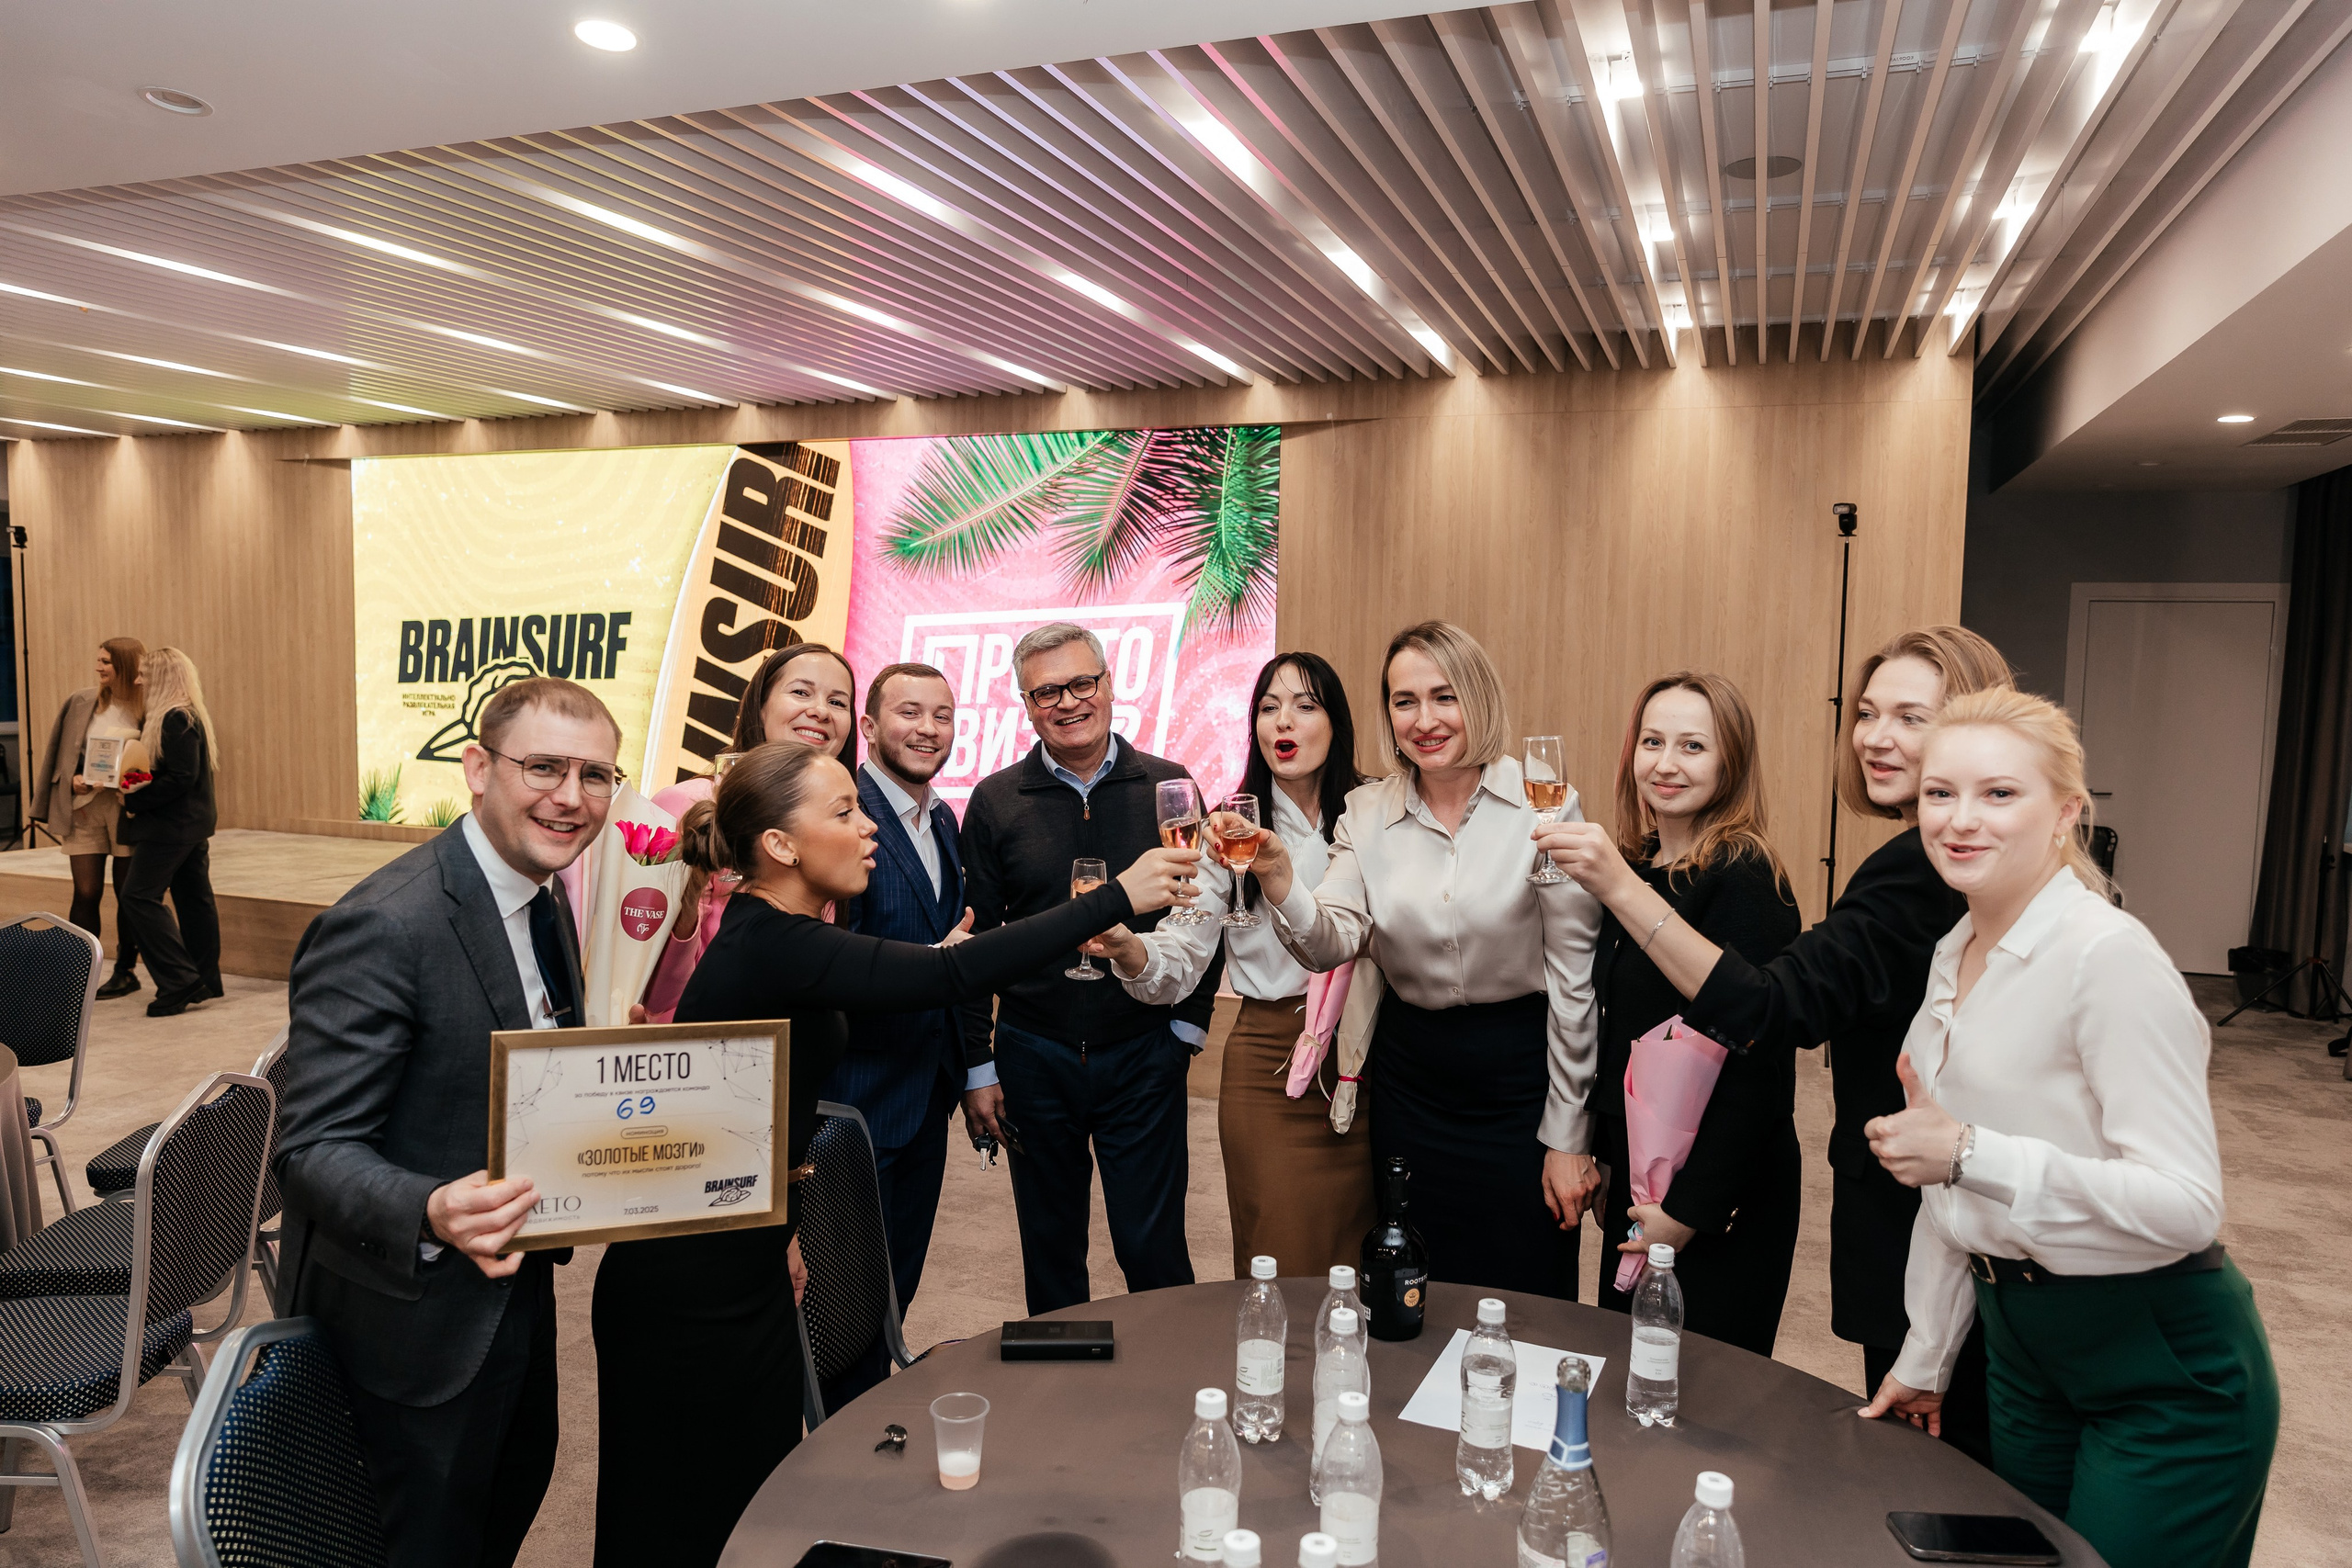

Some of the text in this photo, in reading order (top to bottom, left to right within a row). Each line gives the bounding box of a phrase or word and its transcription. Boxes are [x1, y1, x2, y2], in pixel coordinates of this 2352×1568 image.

[398, 611, 632, 683] BRAINSURF
[624, 906, 665, 920] THE VASE
[597, 1052, 691, 1084] 1 МЕСТО
[584, 1090, 608, 1099] победу
[635, 1087, 682, 1096] награждается
[577, 1141, 706, 1167] «ЗОЛОТЫЕ МОЗГИ»
[705, 1174, 759, 1194] BRAINSURF
[624, 1204, 660, 1216] 7.03.2025
[526, 1214, 581, 1224] едвижимость
